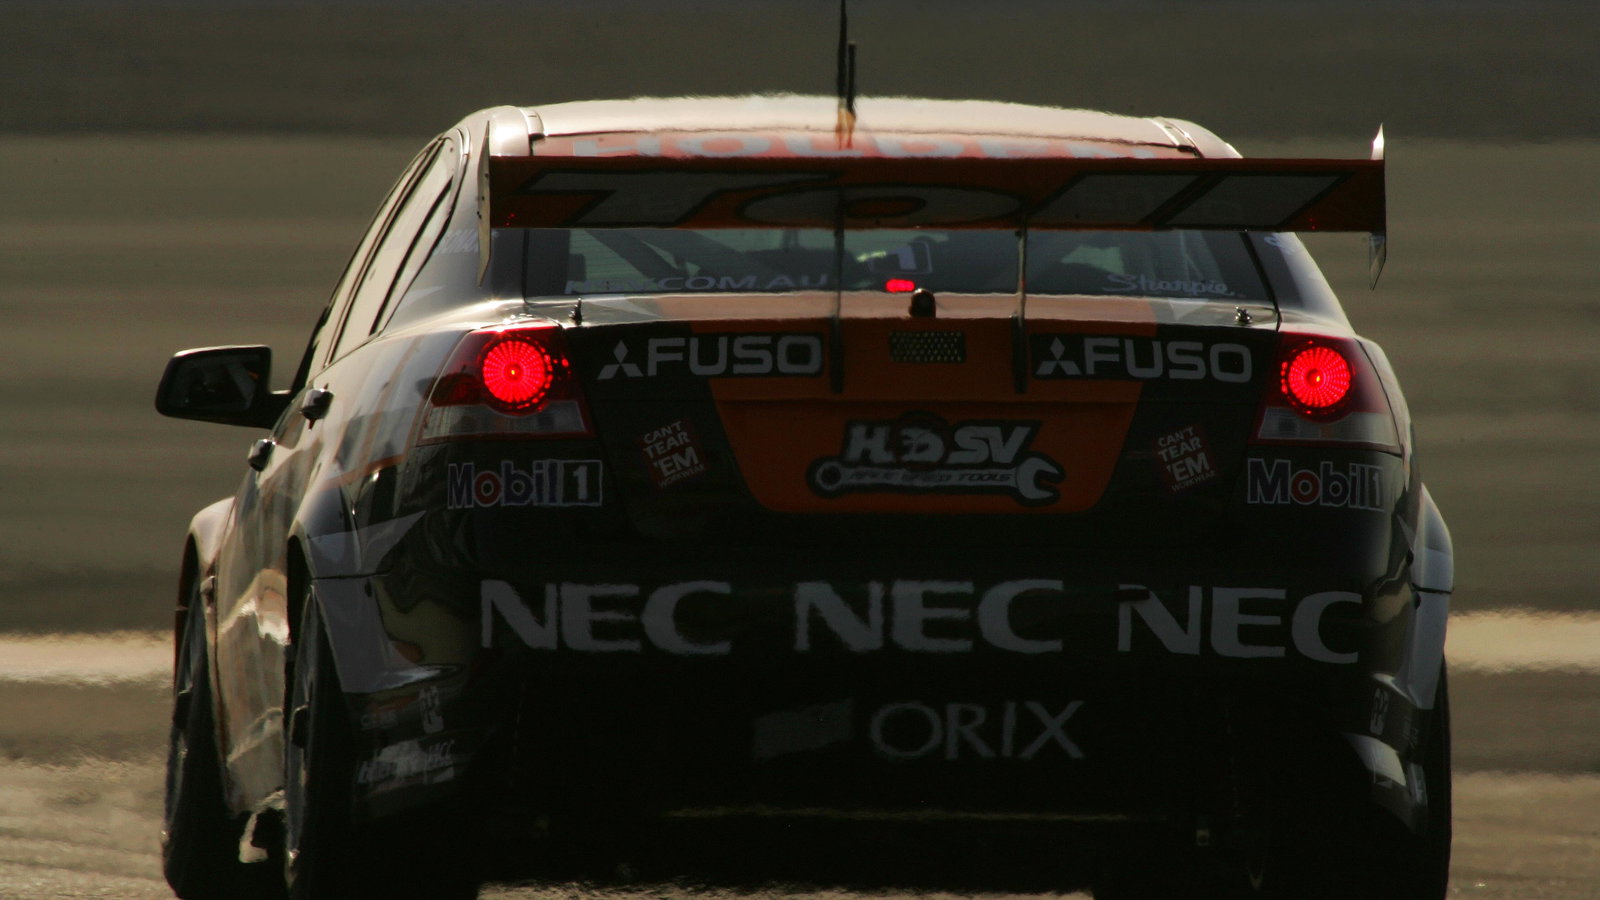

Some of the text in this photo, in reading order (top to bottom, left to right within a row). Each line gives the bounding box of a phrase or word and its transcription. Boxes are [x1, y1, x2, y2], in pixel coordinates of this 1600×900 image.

[1102, 274, 1235, 297] Sharpie
[647, 336, 823, 376] FUSO
[1085, 337, 1253, 384] FUSO
[643, 431, 692, 460] TEAR
[1157, 436, 1202, 462] TEAR
[447, 459, 559, 509] Mobil
[958, 472, 1012, 484] TOOLS
[1247, 457, 1368, 509] Mobil
[480, 579, 732, 656] NEC
[793, 578, 1064, 655] NEC
[1117, 583, 1363, 665] NEC
[869, 700, 1087, 761] ORIX
